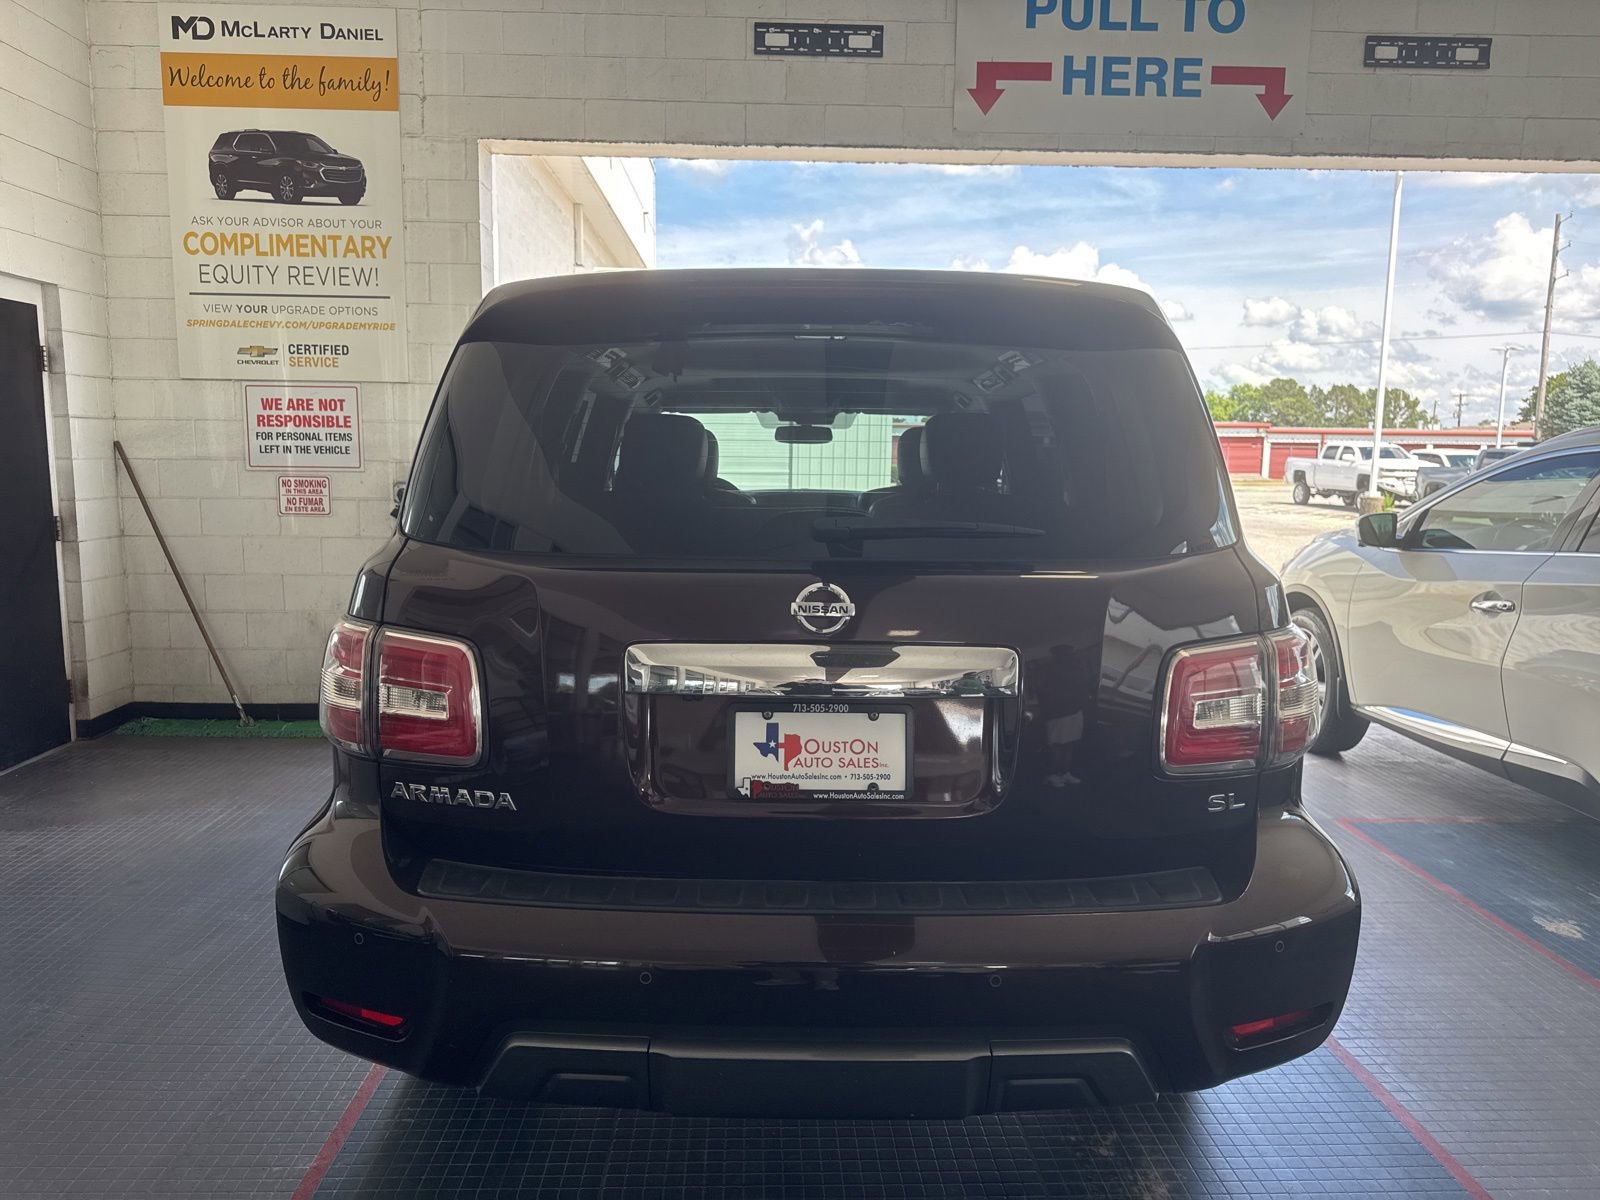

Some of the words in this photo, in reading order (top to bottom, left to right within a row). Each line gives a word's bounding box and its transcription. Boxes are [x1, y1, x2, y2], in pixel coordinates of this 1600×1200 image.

[1025, 0, 1158, 32] PULL
[1177, 0, 1246, 34] TO
[169, 63, 254, 89] Welcome
[258, 66, 275, 90] to
[282, 64, 314, 91] the
[318, 65, 391, 102] family!
[1062, 55, 1203, 98] HERE
[191, 216, 214, 226] ASK
[216, 216, 249, 227] YOUR
[253, 217, 304, 228] ADVISOR
[307, 218, 346, 229] ABOUT
[350, 219, 382, 229] YOUR
[183, 231, 392, 259] COMPLIMENTARY
[199, 263, 279, 285] EQUITY
[288, 265, 380, 287] REVIEW!
[203, 303, 233, 313] VIEW
[236, 304, 268, 314] YOUR
[271, 305, 325, 316] UPGRADE
[329, 306, 379, 316] OPTIONS
[186, 319, 396, 331] SPRINGDALECHEVY.COM/UPGRADEMYRIDE
[288, 343, 349, 356] CERTIFIED
[289, 356, 339, 368] SERVICE
[260, 397, 283, 411] WE
[286, 398, 314, 412] ARE
[318, 399, 346, 412] NOT
[256, 414, 352, 428] RESPONSIBLE
[256, 432, 274, 441] FOR
[276, 432, 322, 442] PERSONAL
[325, 432, 353, 442] ITEMS
[259, 445, 280, 454] LEFT
[283, 445, 292, 454] IN
[295, 445, 312, 454] THE
[314, 446, 351, 455] VEHICLE
[282, 479, 292, 488] NO
[294, 479, 327, 489] SMOKING
[286, 498, 297, 506] NO
[299, 498, 324, 506] FUMAR
[798, 605, 849, 614] NISSAN
[793, 703, 849, 713] 713-505-2900
[793, 757, 833, 769] AUTO
[838, 757, 879, 769] SALES
[751, 773, 842, 781] www.HoustonAutoSalesInc.com
[850, 773, 891, 781] 713-505-2900
[390, 781, 517, 811] ARMADA
[813, 792, 904, 800] www.HoustonAutoSalesInc.com
[1207, 792, 1246, 813] SL
